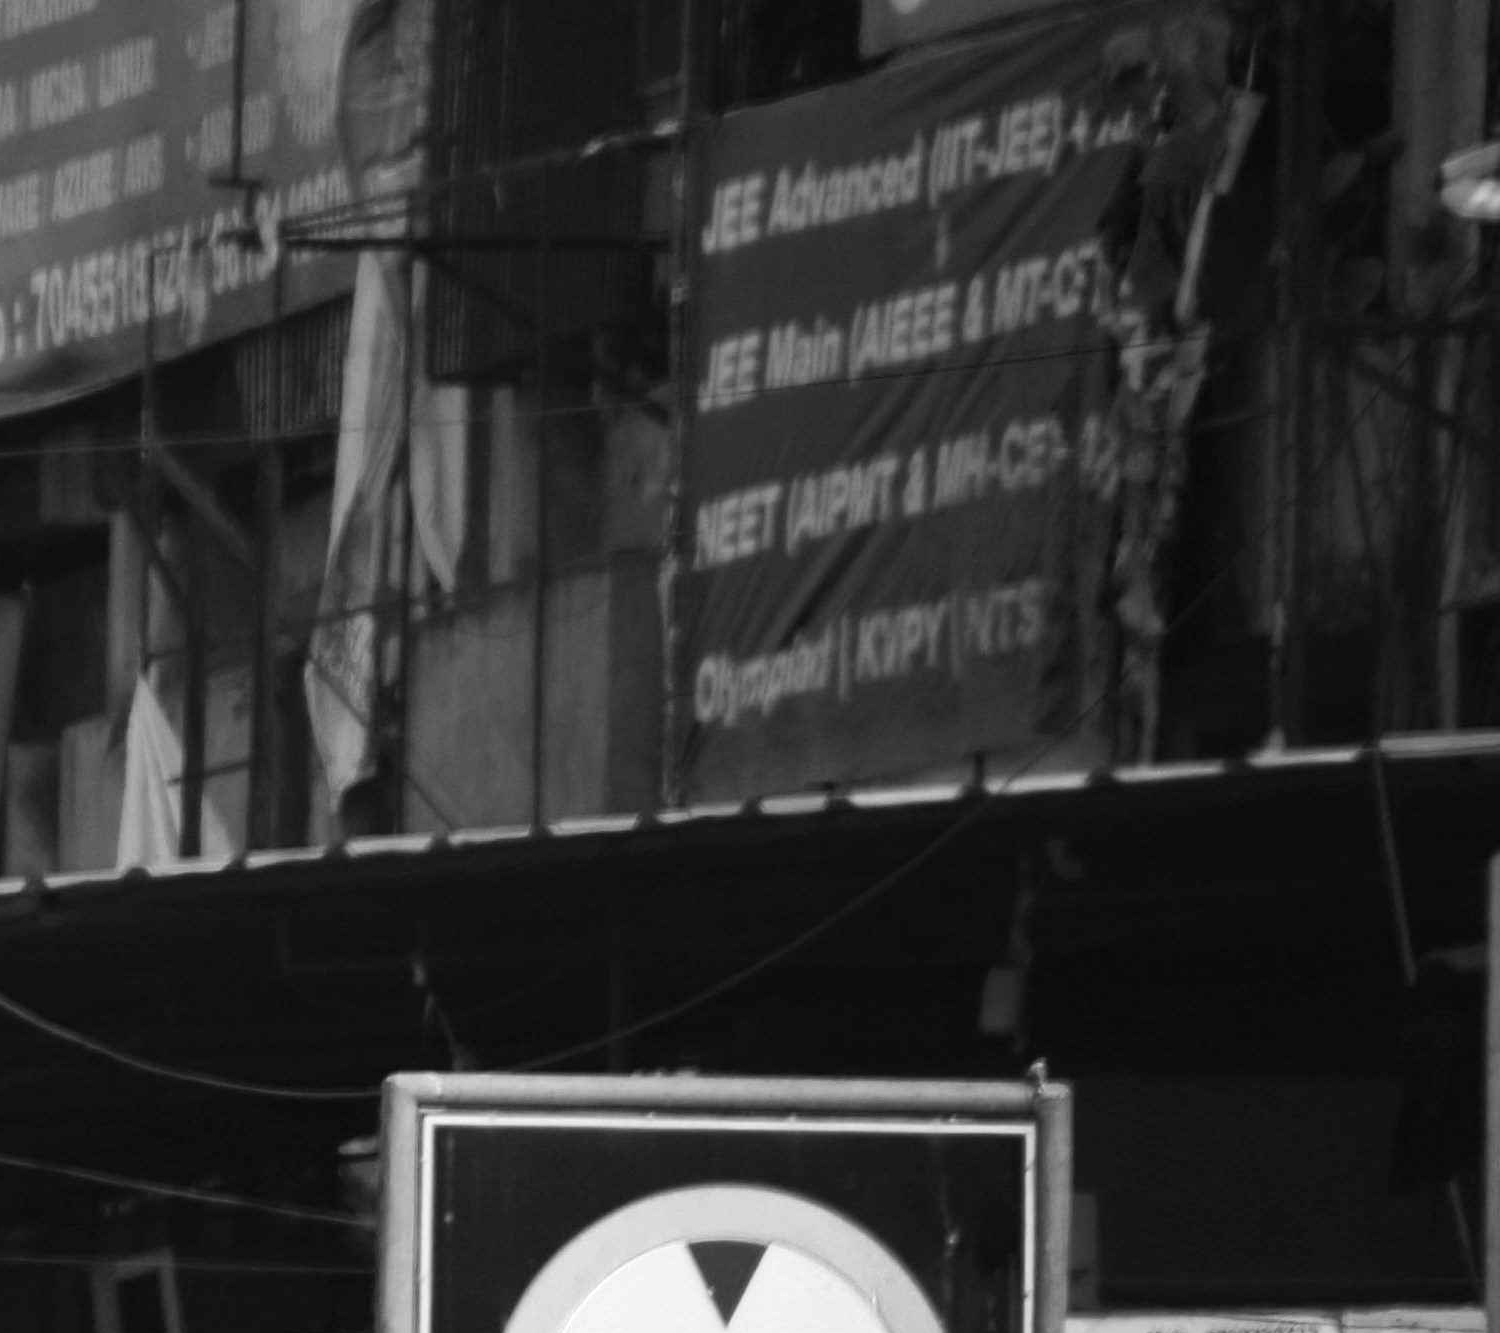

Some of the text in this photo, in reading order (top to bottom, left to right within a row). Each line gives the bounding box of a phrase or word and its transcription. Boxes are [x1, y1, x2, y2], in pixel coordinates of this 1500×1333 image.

[701, 173, 767, 257] JEE
[767, 130, 924, 234] Advanced
[698, 329, 762, 413] JEE
[766, 314, 843, 389] Main
[693, 481, 781, 572] NEET
[695, 622, 834, 729] Olympiad
